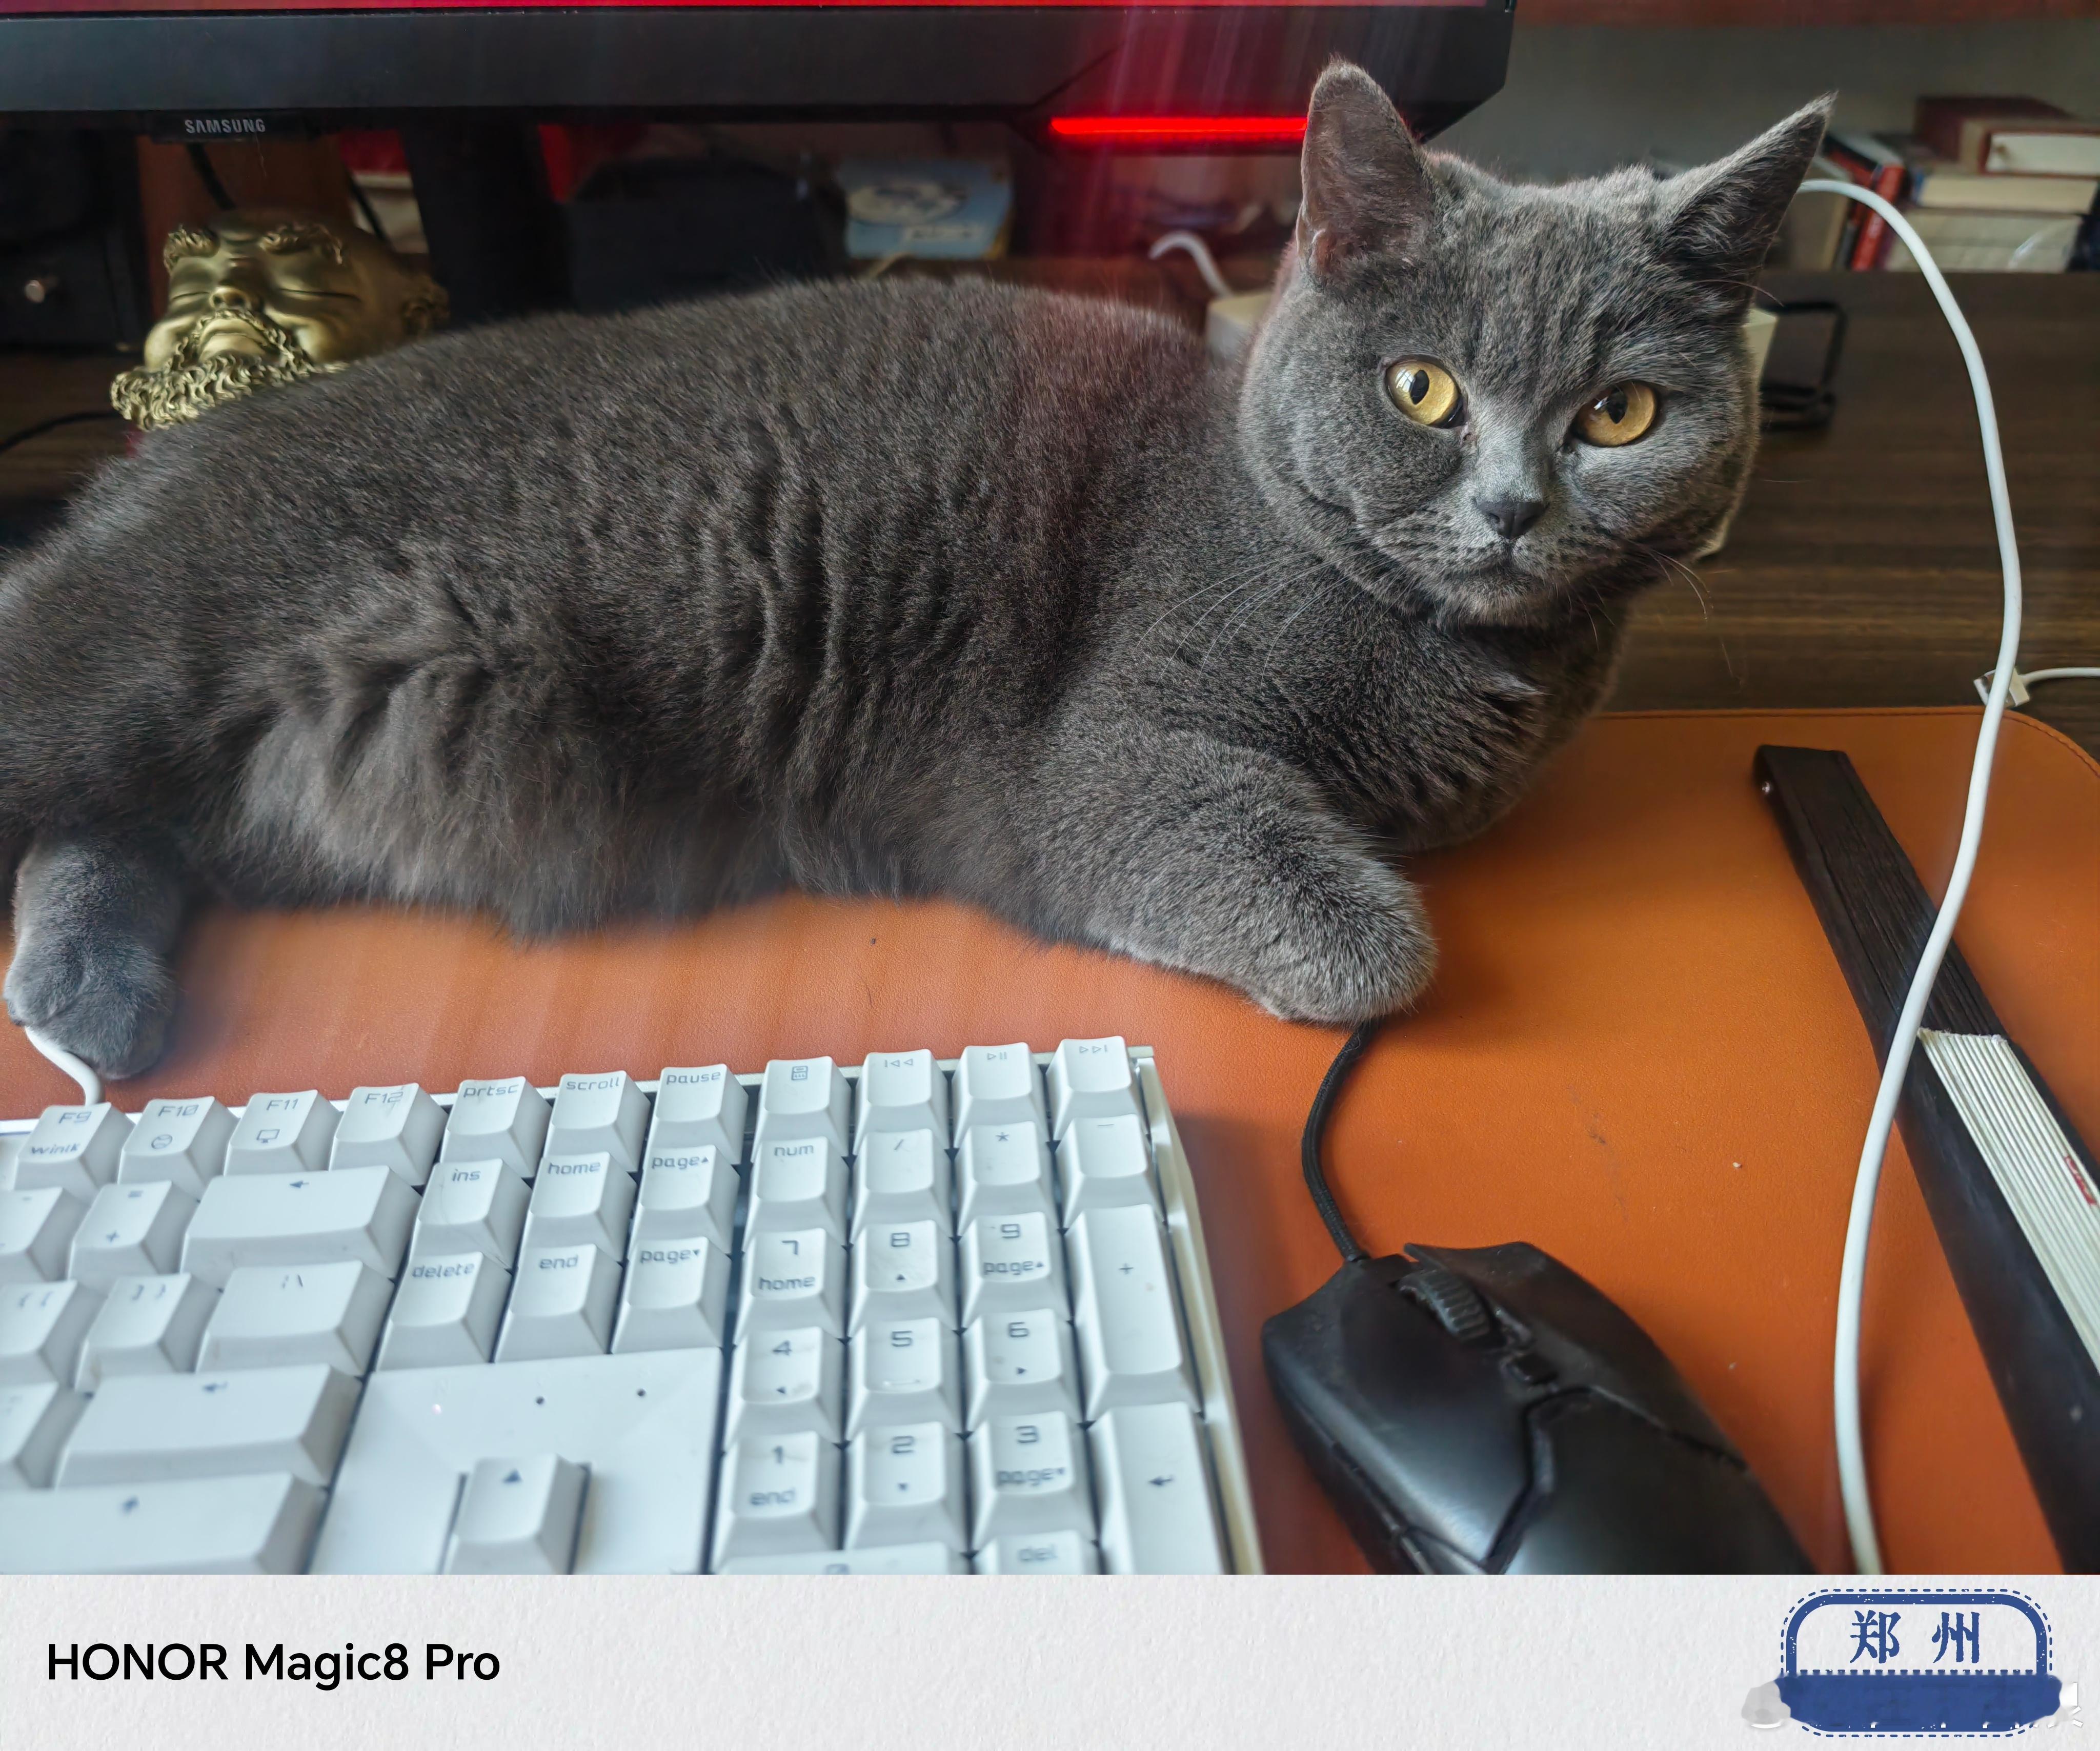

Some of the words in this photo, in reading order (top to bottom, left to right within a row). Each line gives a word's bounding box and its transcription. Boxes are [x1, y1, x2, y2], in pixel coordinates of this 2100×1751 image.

[185, 118, 266, 134] SAMSUNG
[566, 1076, 619, 1091] scroll
[666, 1072, 721, 1085] pause
[364, 1091, 403, 1104] F12
[463, 1084, 518, 1098] prtsc
[157, 1104, 199, 1117] F10
[266, 1098, 299, 1111] F11
[58, 1111, 92, 1124] F9
[774, 1145, 814, 1156] num
[548, 1162, 601, 1175] home
[651, 1156, 700, 1170] page
[452, 1168, 481, 1182] ins
[1000, 1223, 1021, 1239] 9
[781, 1239, 799, 1255] 7
[890, 1232, 911, 1248] 8
[538, 1255, 579, 1270] end
[639, 1250, 691, 1265] page
[411, 1264, 475, 1278] delete
[983, 1260, 1034, 1276] page
[758, 1276, 815, 1291] home
[1007, 1321, 1030, 1338] 6
[891, 1330, 913, 1348] 5
[772, 1340, 792, 1356] 4
[1016, 1425, 1039, 1444] 3
[891, 1435, 916, 1455] 2
[772, 1445, 784, 1464] 1
[997, 1468, 1055, 1487] page
[749, 1487, 796, 1506] end
